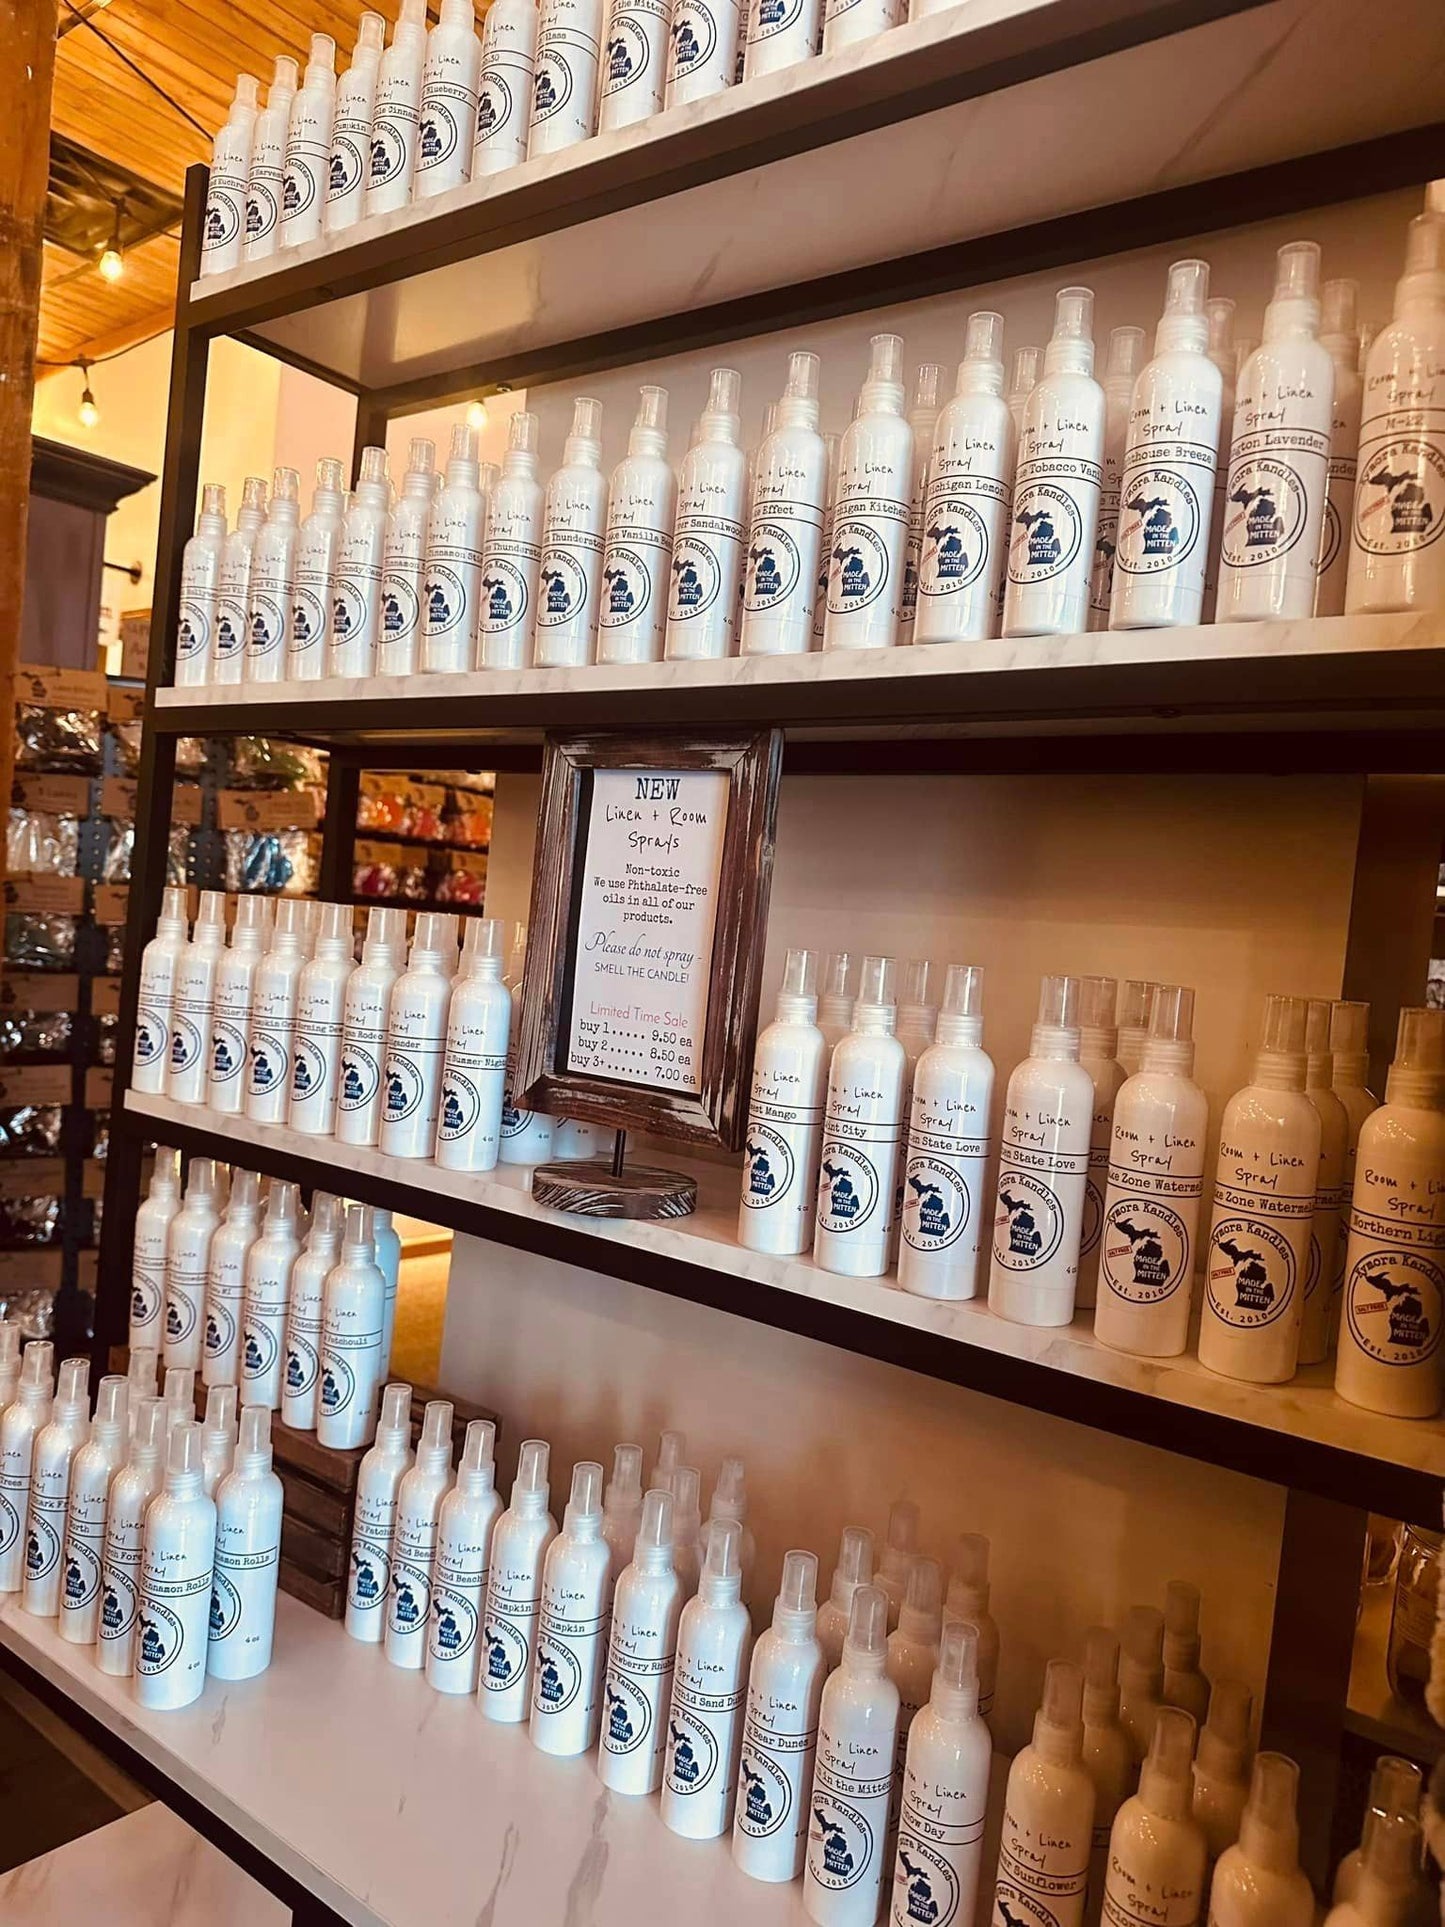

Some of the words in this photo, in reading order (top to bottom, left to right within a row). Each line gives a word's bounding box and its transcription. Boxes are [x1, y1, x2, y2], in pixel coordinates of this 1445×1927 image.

[426, 85, 468, 100] Blueberry
[1278, 386, 1314, 400] Linen
[1175, 400, 1208, 416] Linen
[1057, 417, 1088, 432] Linen
[1245, 407, 1286, 428] Spray
[1142, 422, 1183, 439] Spray
[965, 437, 995, 452] Linen
[1029, 438, 1064, 455] Spray
[1270, 434, 1325, 450] Lavender
[1175, 446, 1212, 464] Breeze
[779, 466, 806, 479] Linen
[865, 462, 894, 475] Linen
[938, 457, 972, 473] Spray
[1031, 463, 1076, 474] Tobacco
[1256, 461, 1299, 494] Kandles
[842, 479, 872, 497] Spray
[976, 481, 1005, 499] Lemon
[1153, 472, 1193, 506] Kandles
[1037, 486, 1074, 517] Kandles
[762, 505, 796, 517] Effect
[946, 502, 981, 533] Kandles
[621, 529, 660, 546] Vanilla
[849, 525, 882, 553] Kandles
[1147, 553, 1174, 570] 2010
[1250, 546, 1278, 562] 2010
[1031, 565, 1055, 579] 2010
[940, 578, 963, 591] 2010
[635, 778, 681, 801] NEW
[606, 804, 642, 823] Linen
[652, 808, 660, 821] +
[670, 806, 708, 827] Room
[628, 831, 680, 855] Sprays
[625, 863, 681, 878] Non-toxic
[594, 876, 606, 888] We
[608, 879, 626, 890] use
[628, 879, 708, 897] Phthalate-free
[602, 893, 625, 904] oils
[627, 895, 640, 906] in
[642, 896, 659, 907] all
[661, 898, 675, 910] of
[675, 900, 696, 911] our
[623, 911, 673, 925] products.
[584, 930, 627, 957] Please
[628, 932, 646, 957] do
[644, 946, 661, 958] not
[663, 949, 694, 970] spray
[594, 961, 624, 976] SMELL
[628, 965, 645, 978] THE
[647, 968, 690, 985] CANDLE!
[590, 1000, 630, 1020] Limited
[633, 1006, 661, 1025] Time
[663, 1010, 689, 1030] Sale
[580, 1018, 600, 1036] buy
[652, 1029, 677, 1046] 9.50
[679, 1036, 693, 1048] ea
[578, 1035, 598, 1053] buy
[650, 1046, 676, 1063] 8.50
[677, 1053, 692, 1066] ea
[571, 1051, 591, 1069] buy
[655, 1065, 680, 1082] 7.00
[682, 1073, 697, 1085] ea
[773, 1070, 801, 1084] Linen
[754, 1084, 779, 1100] Spray
[854, 1086, 883, 1100] Linen
[765, 1106, 797, 1120] Mango
[832, 1100, 861, 1117] Spray
[946, 1098, 977, 1113] Linen
[920, 1113, 953, 1132] Spray
[1038, 1111, 1071, 1127] Linen
[842, 1124, 867, 1139] City
[1011, 1126, 1045, 1147] Spray
[1114, 1125, 1139, 1143] Room
[1164, 1133, 1196, 1148] Linen
[757, 1126, 787, 1157] Kandles
[921, 1136, 952, 1150] State
[955, 1141, 981, 1153] Love
[838, 1145, 871, 1177] Kandles
[1014, 1152, 1045, 1166] State
[1047, 1156, 1076, 1170] Love
[1130, 1149, 1172, 1171] Spray
[1220, 1141, 1244, 1159] Room
[1269, 1152, 1305, 1167] Linen
[928, 1159, 963, 1194] Kandles
[1121, 1172, 1151, 1188] Zone
[1235, 1167, 1278, 1190] Spray
[1364, 1168, 1397, 1187] Room
[1019, 1175, 1057, 1212] Kandles
[1225, 1191, 1255, 1208] Zone
[1387, 1196, 1436, 1220] Spray
[833, 1218, 855, 1230] 2010
[1143, 1202, 1184, 1238] Kandles
[1352, 1213, 1412, 1241] Northern
[921, 1238, 945, 1248] 2010
[1246, 1222, 1290, 1261] Kandles
[1012, 1253, 1037, 1267] 2010
[1135, 1254, 1160, 1265] MADE
[1354, 1255, 1397, 1279] Kymora
[1137, 1268, 1167, 1280] MITTEN
[1238, 1278, 1262, 1289] MADE
[1137, 1287, 1165, 1299] 2010
[1239, 1293, 1271, 1305] MITTEN
[1240, 1312, 1269, 1324] 2010
[1363, 1337, 1387, 1357] Est.
[243, 1554, 270, 1567] Rolls
[186, 1576, 210, 1593] Rolls
[456, 1574, 483, 1585] Beach
[493, 1598, 532, 1615] Pumpkin
[697, 1658, 726, 1673] Linen
[699, 1696, 724, 1709] Sand
[769, 1695, 798, 1712] Linen
[754, 1728, 775, 1745] Bear
[779, 1736, 809, 1749] Dunes
[849, 1742, 879, 1757] Linen
[825, 1748, 857, 1775] Spray
[836, 1777, 855, 1794] the
[858, 1780, 891, 1795] Mitten
[936, 1784, 967, 1800] Linen
[911, 1789, 943, 1819] Spray
[832, 1799, 867, 1835] Kandles
[924, 1823, 946, 1840] Day
[1039, 1833, 1072, 1850] Linen
[916, 1842, 953, 1883] Kandles
[1011, 1838, 1046, 1870] Spray
[826, 1876, 853, 1888] 2010
[1013, 1863, 1077, 1891] Sunflower
[1127, 1893, 1169, 1923] Spray
